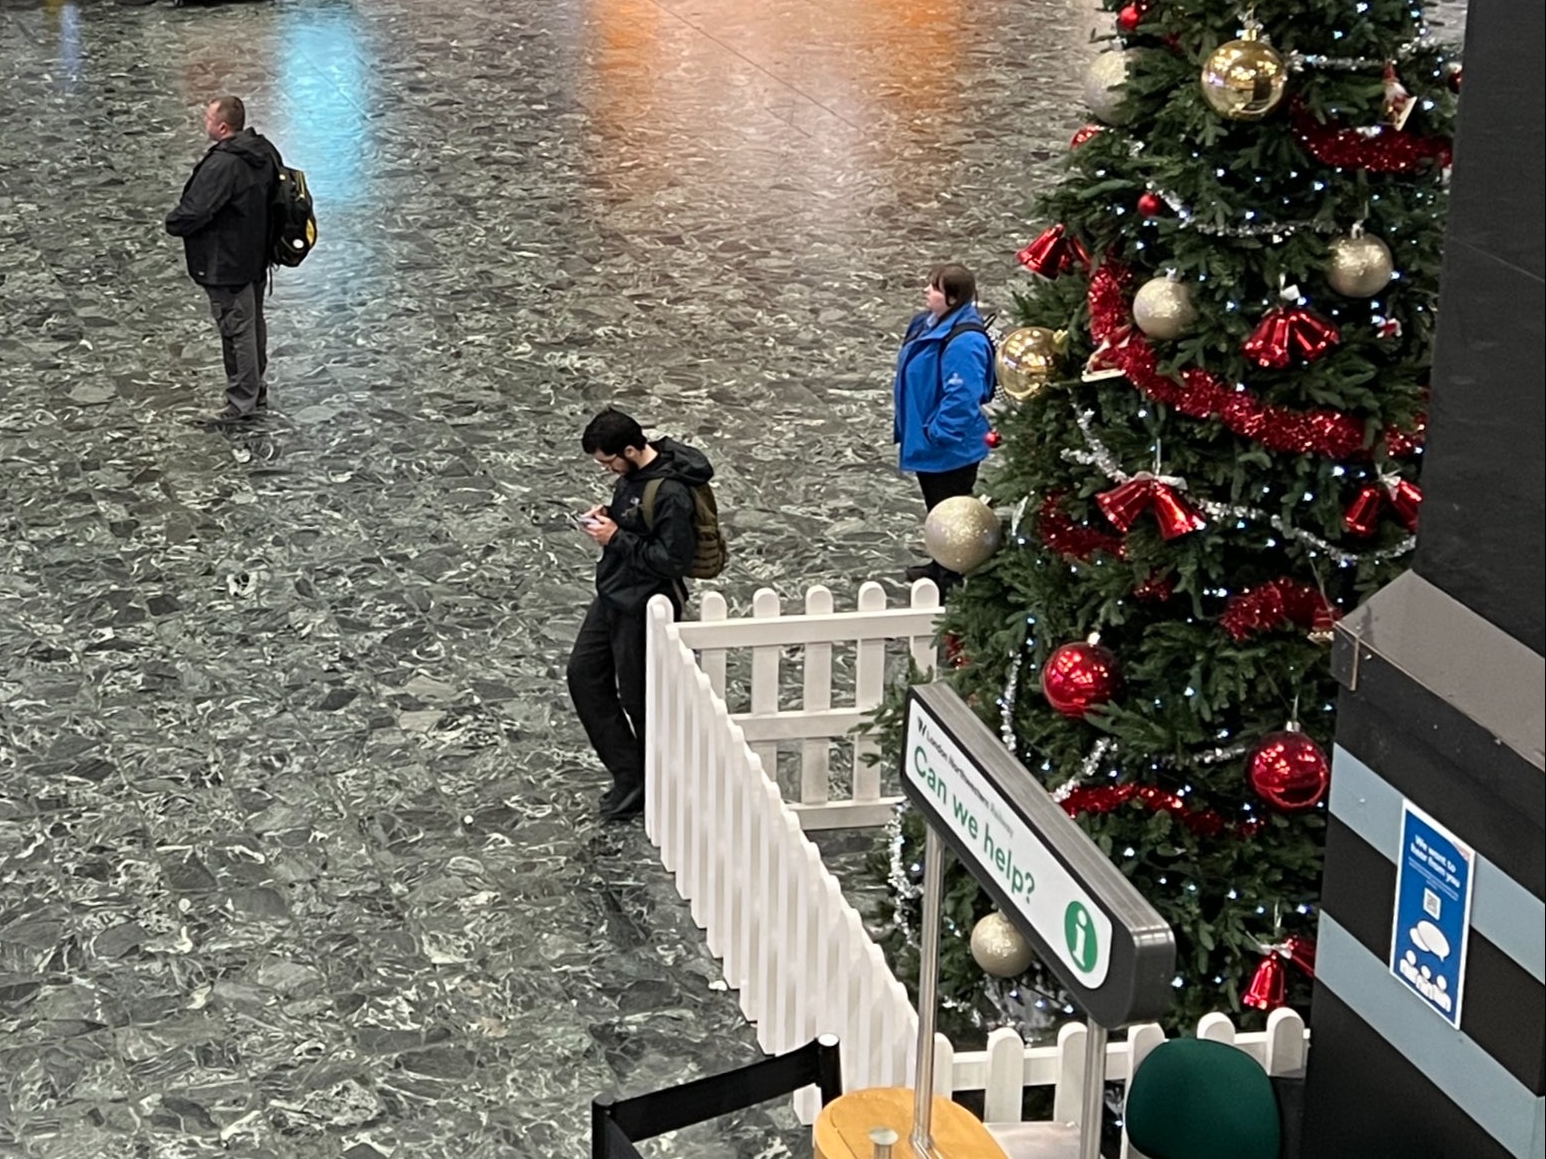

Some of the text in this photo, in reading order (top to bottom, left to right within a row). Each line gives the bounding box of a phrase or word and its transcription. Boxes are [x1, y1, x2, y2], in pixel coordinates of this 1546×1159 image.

[914, 746, 1035, 904] Can we help?
